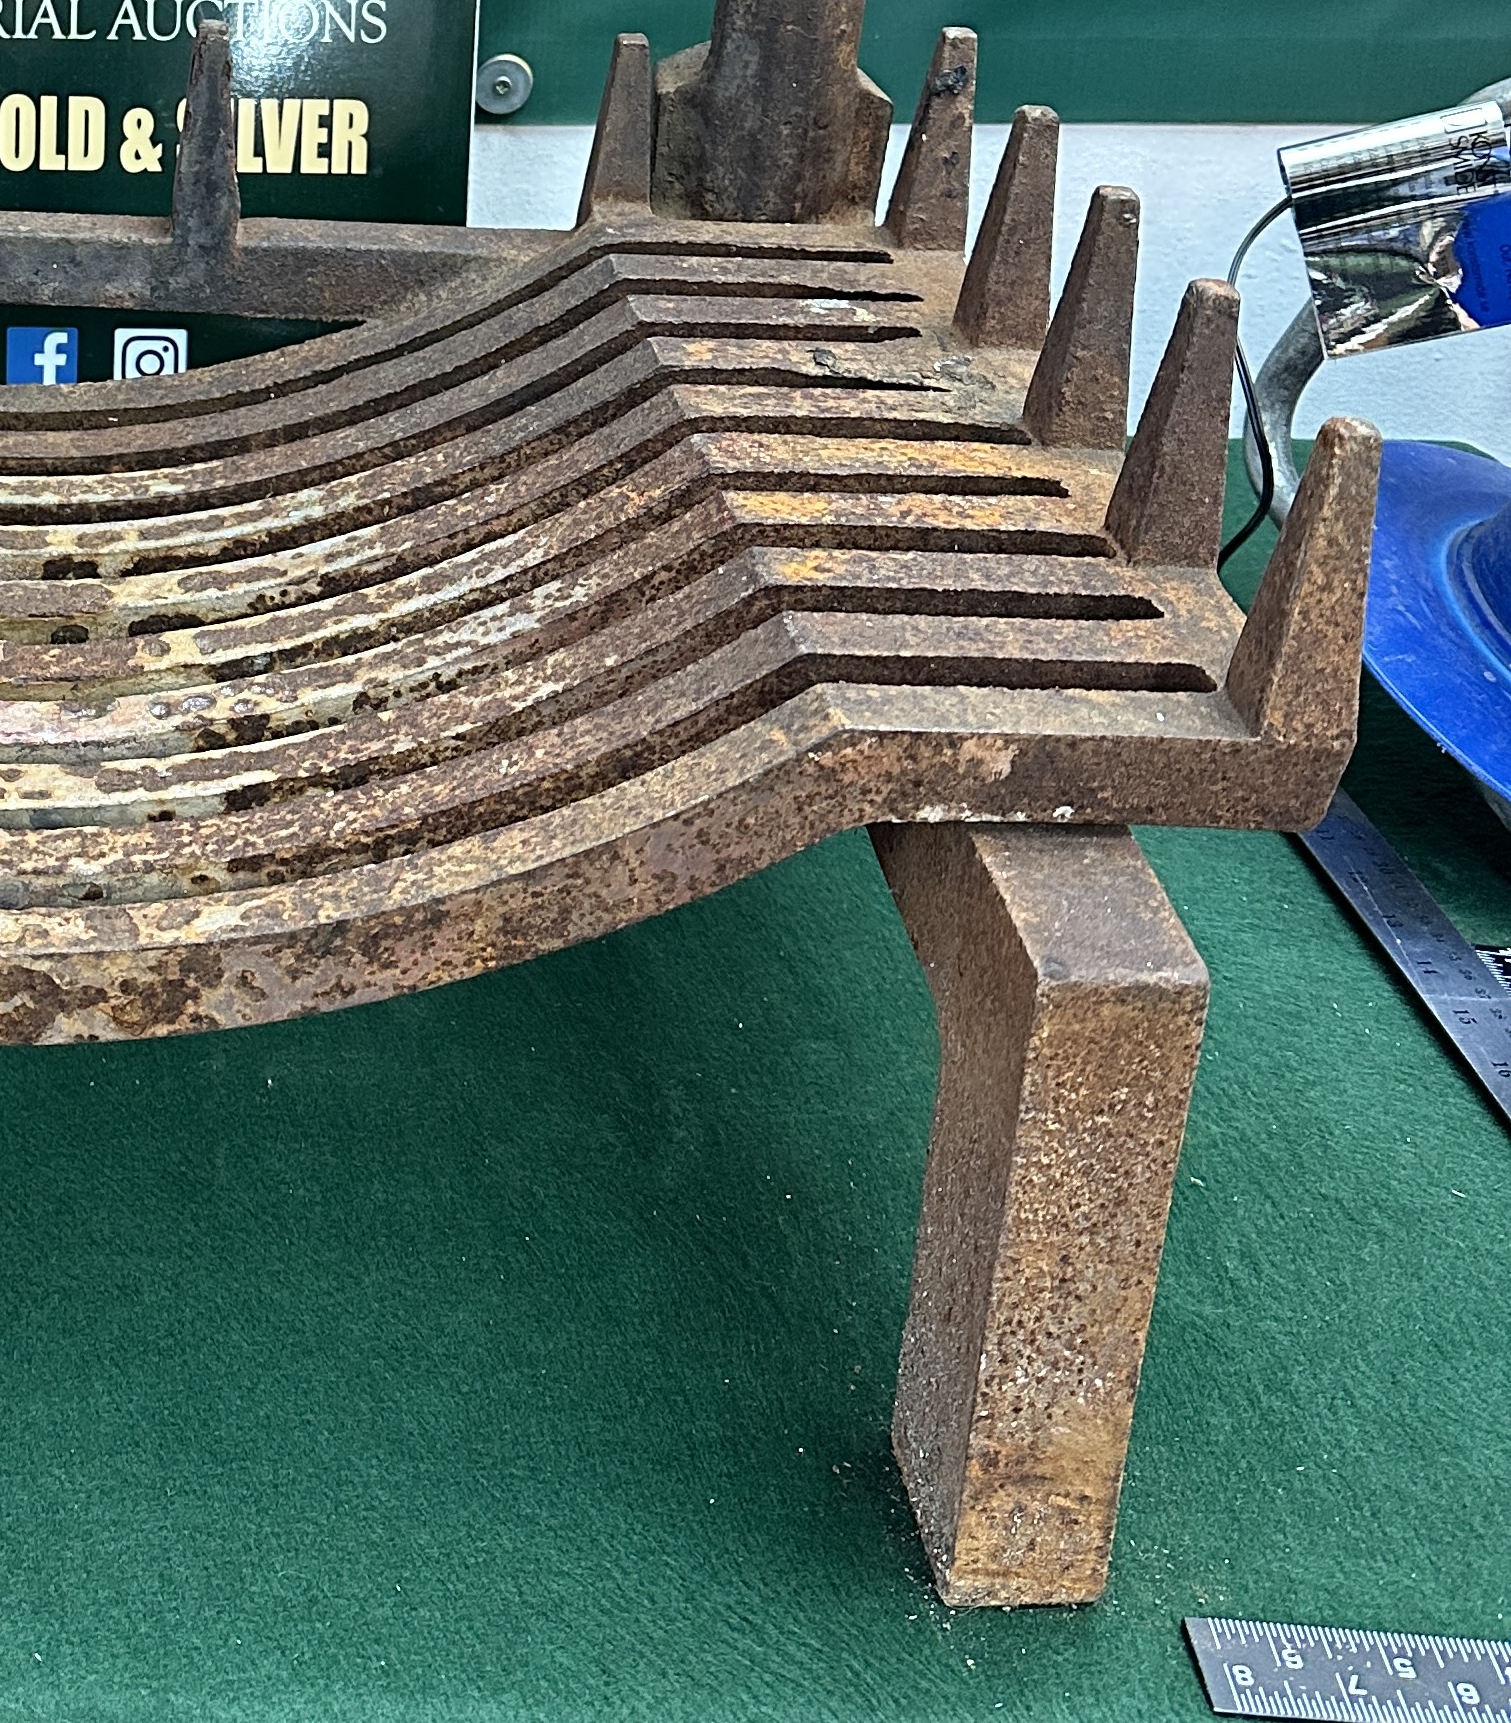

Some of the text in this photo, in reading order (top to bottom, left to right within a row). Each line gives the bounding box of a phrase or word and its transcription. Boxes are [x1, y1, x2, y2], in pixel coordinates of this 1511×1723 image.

[119, 107, 163, 174] &
[1452, 1009, 1479, 1026] 15
[1232, 1664, 1256, 1687] 8
[1348, 1674, 1369, 1697] 7
